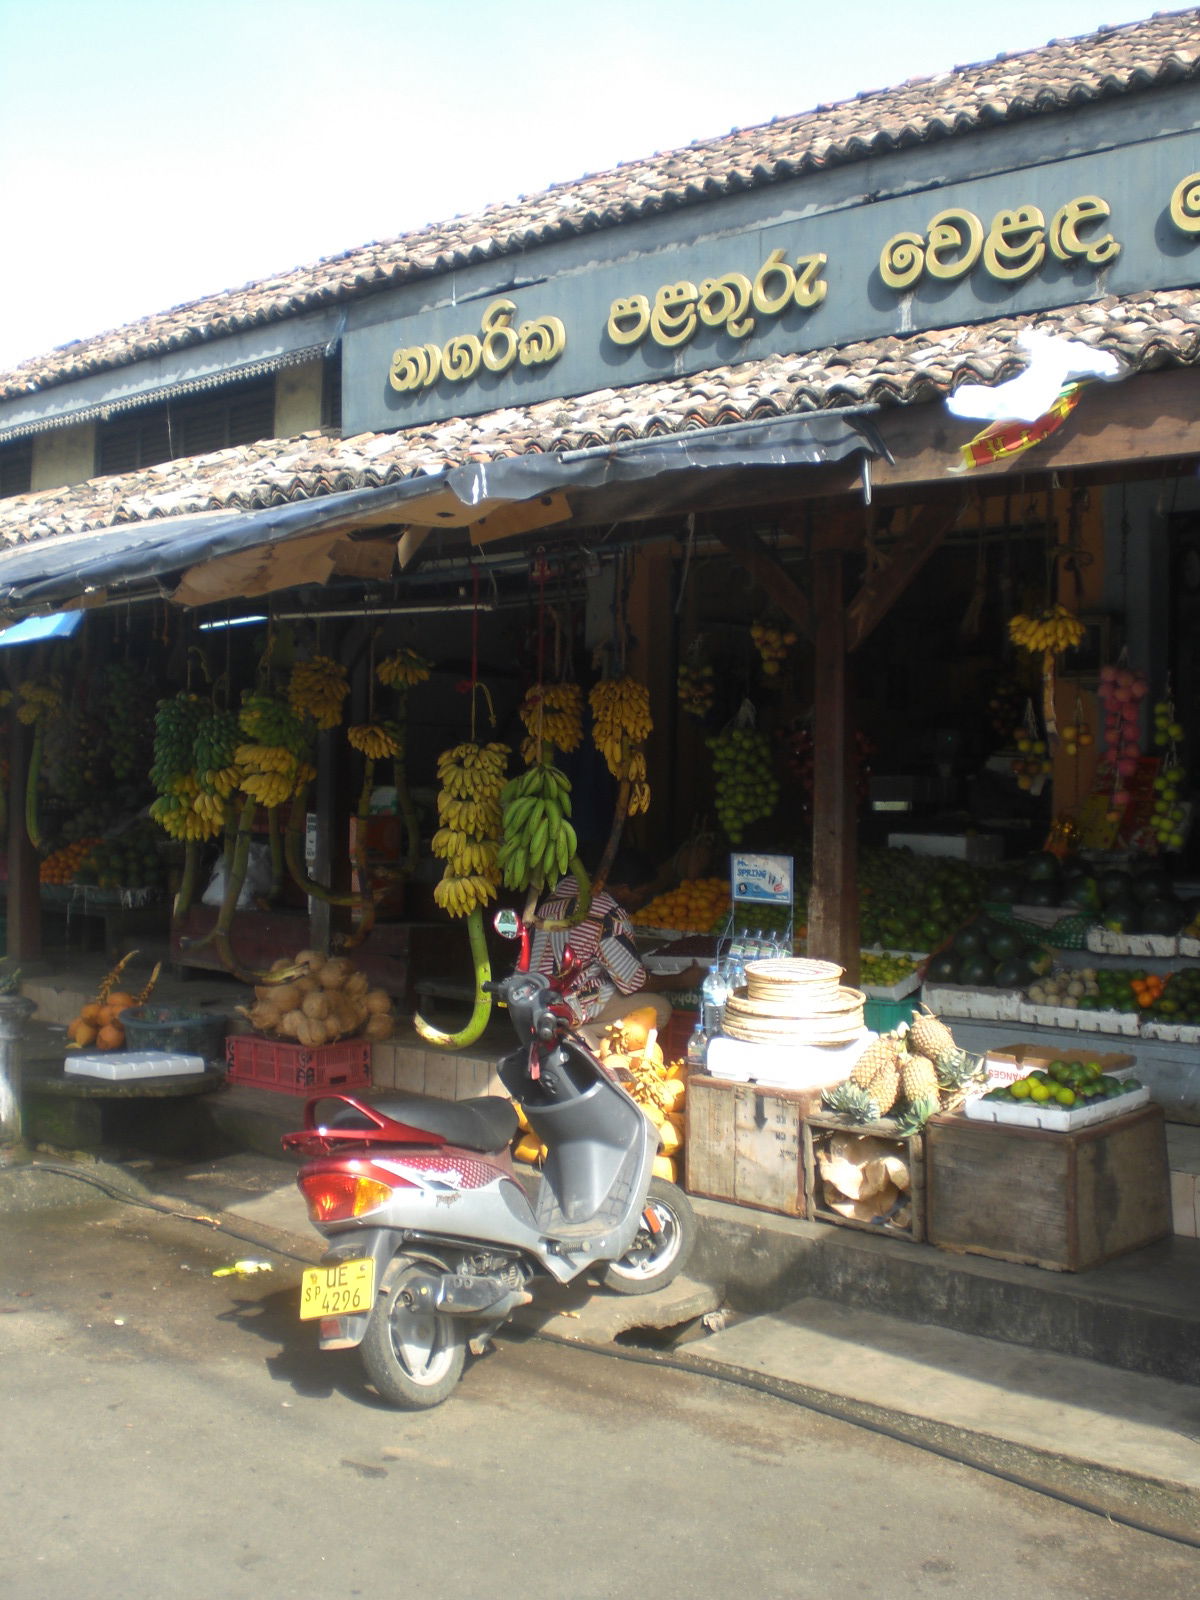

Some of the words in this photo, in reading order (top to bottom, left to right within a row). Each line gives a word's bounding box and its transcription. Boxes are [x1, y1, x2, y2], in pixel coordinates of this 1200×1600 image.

[389, 298, 566, 392] නාගරික
[608, 248, 828, 347] පළතුරු
[326, 1266, 348, 1289] UE
[305, 1285, 321, 1303] SP
[322, 1287, 361, 1313] 4296
